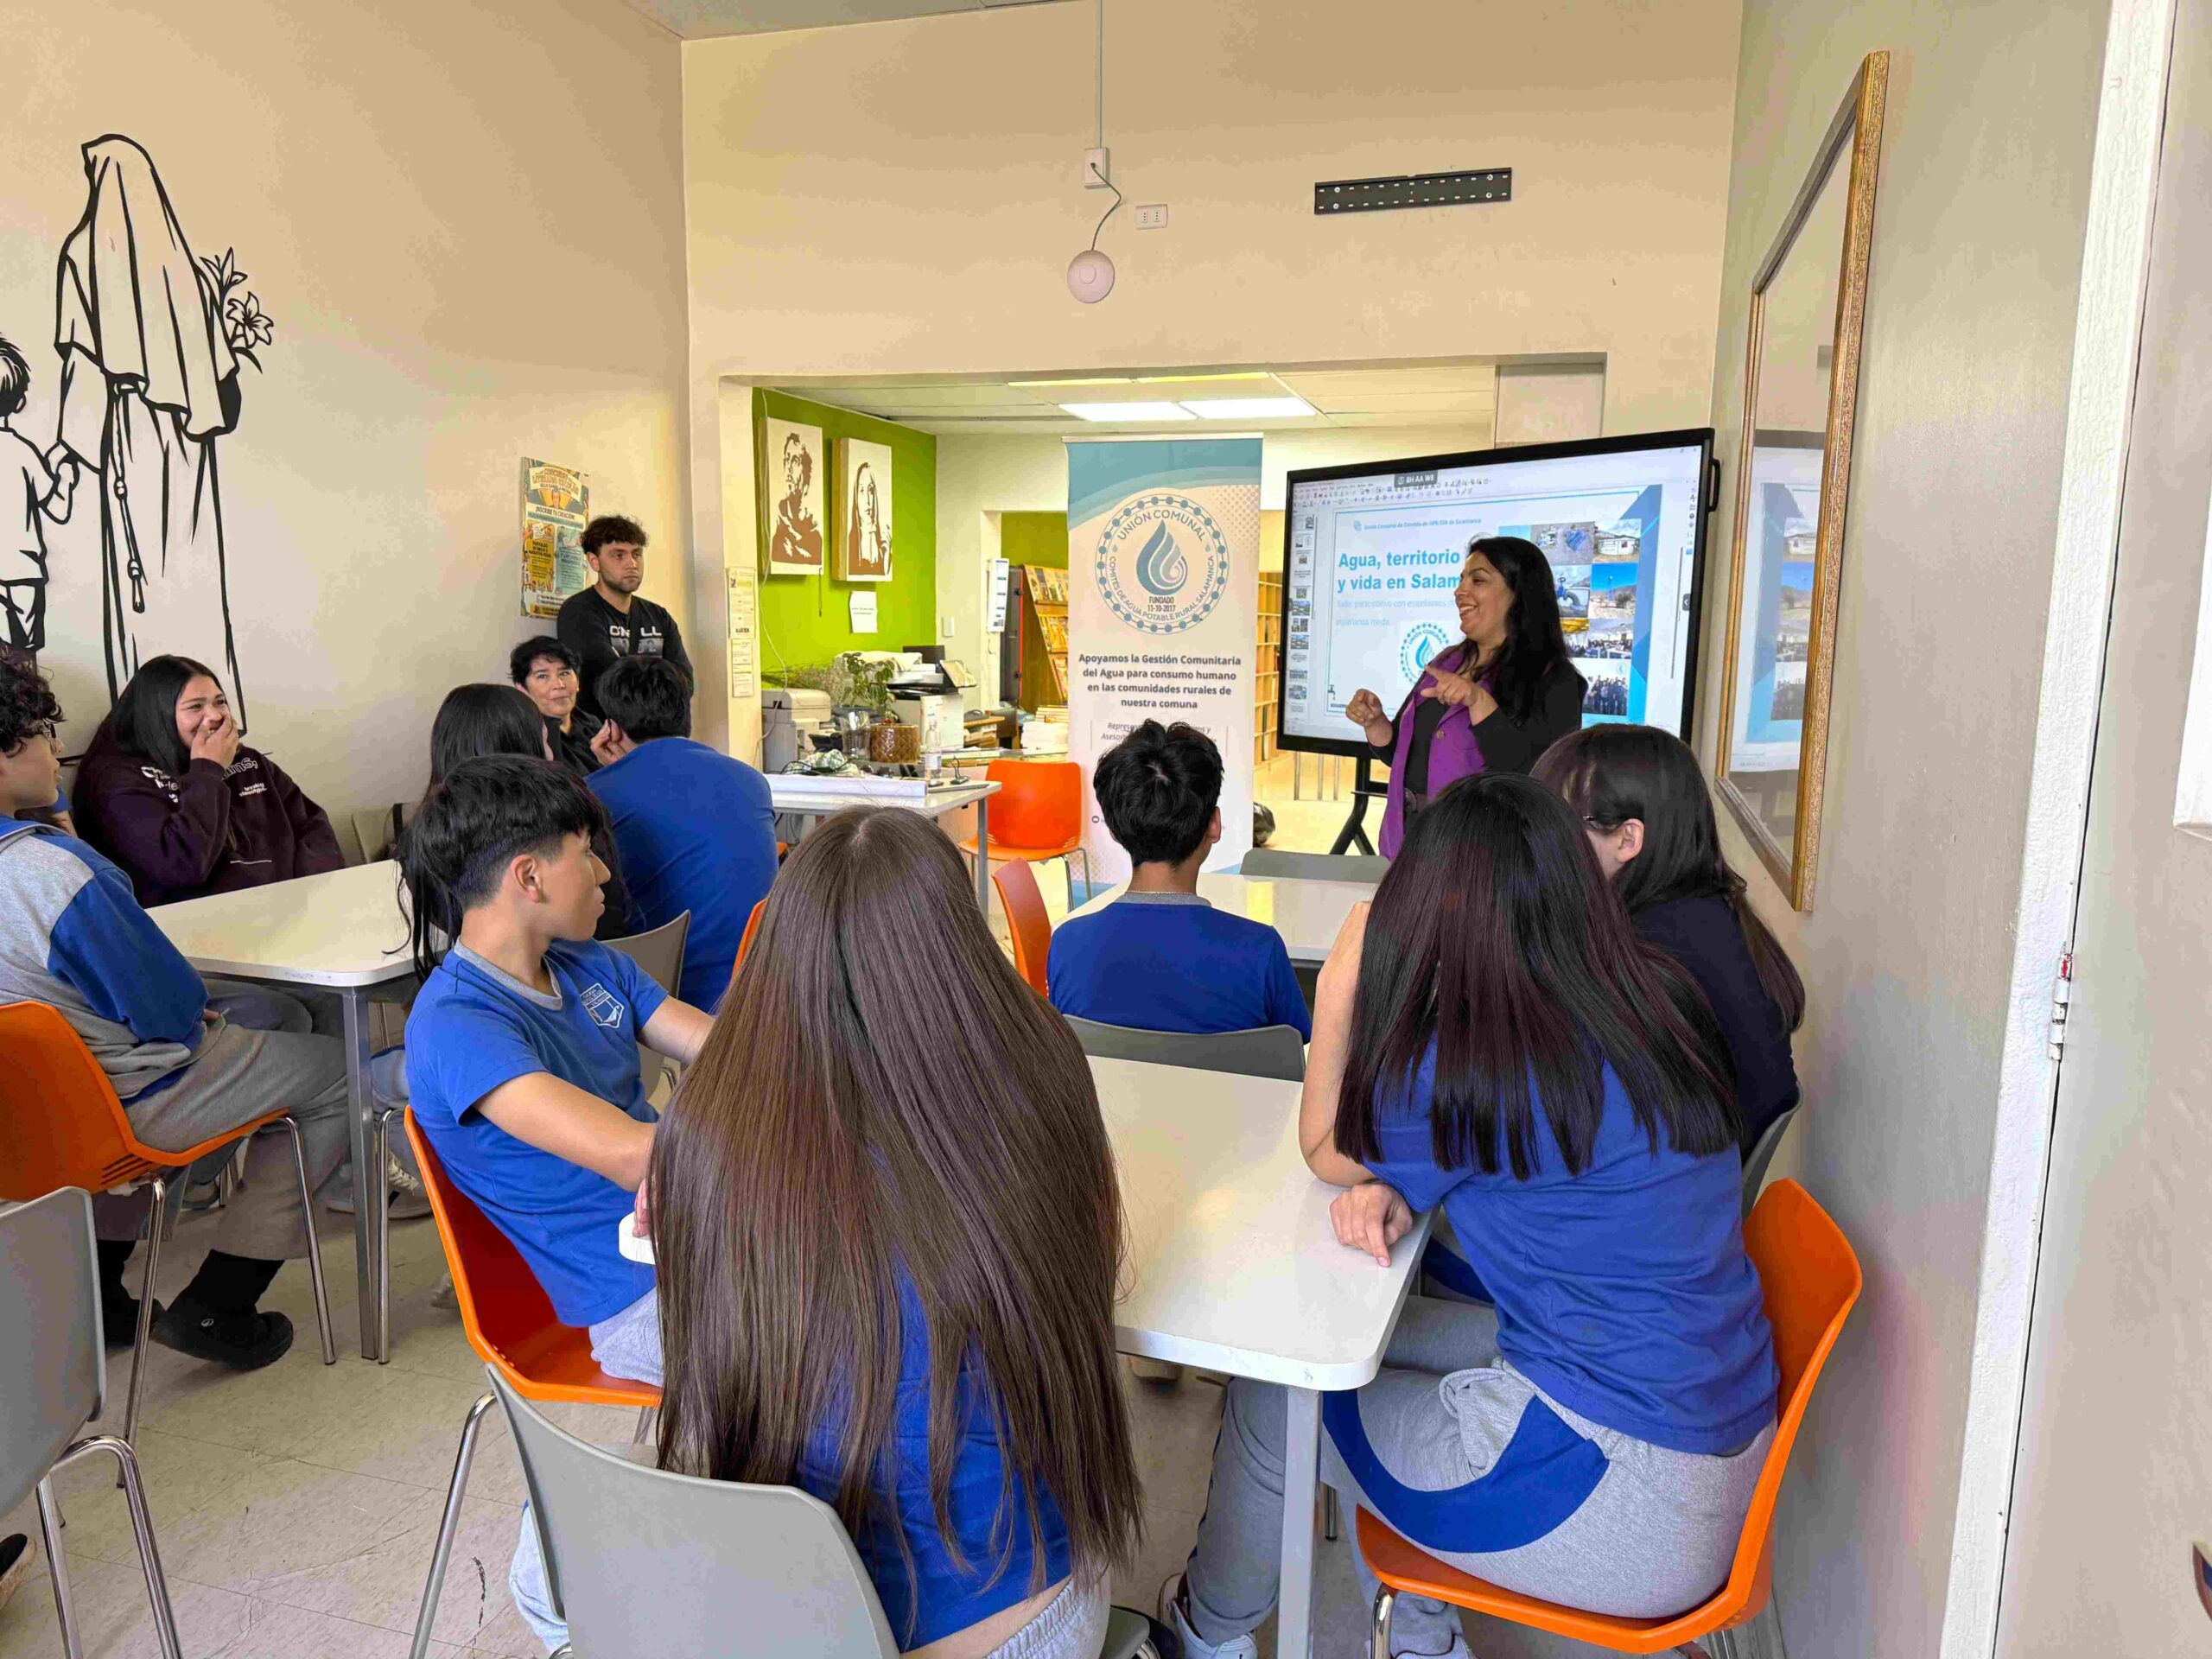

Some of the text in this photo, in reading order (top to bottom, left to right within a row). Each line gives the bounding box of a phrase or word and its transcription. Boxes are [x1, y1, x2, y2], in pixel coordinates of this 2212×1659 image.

[1117, 509, 1206, 542] UNIÓN COMUNAL
[1338, 549, 1460, 570] Agua, territorio
[1116, 590, 1127, 601] DE
[1123, 600, 1141, 615] AGUA
[1141, 611, 1175, 621] POTABLE
[1175, 602, 1198, 618] RURAL
[1195, 556, 1215, 604] SALAMANCA
[1338, 573, 1460, 594] y vida en Salam
[1078, 654, 1242, 666] Apoyamos la Gestión Comunitaria
[1083, 668, 1236, 681] del Agua para consumo humano
[1087, 683, 1231, 696] en las comunidades rurales de
[1121, 698, 1198, 709] nuestra comuna
